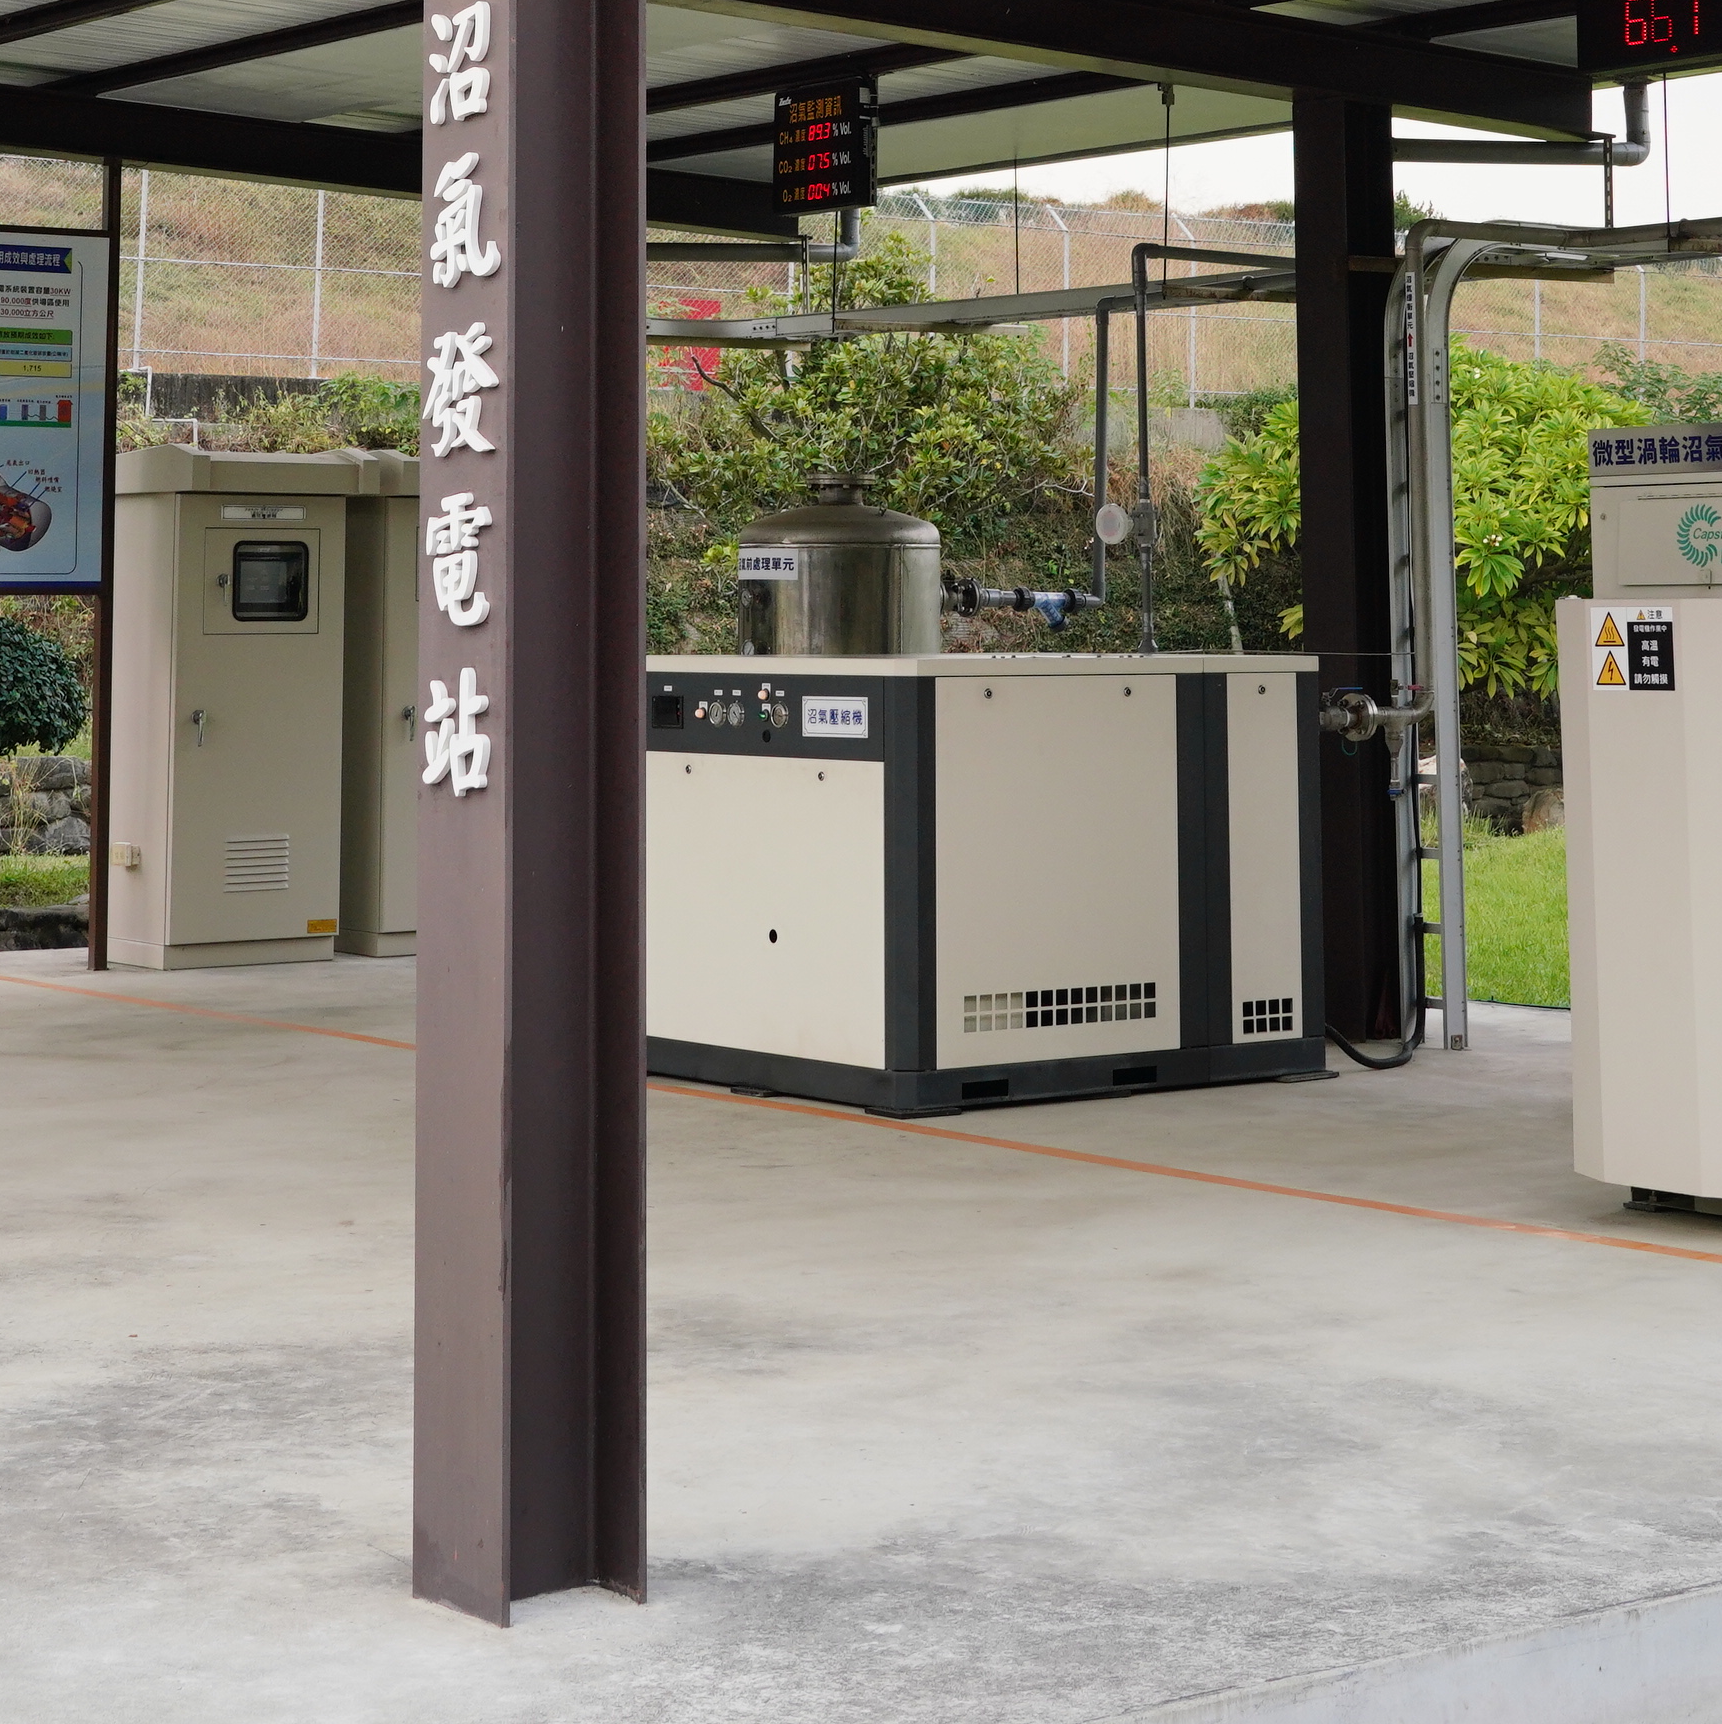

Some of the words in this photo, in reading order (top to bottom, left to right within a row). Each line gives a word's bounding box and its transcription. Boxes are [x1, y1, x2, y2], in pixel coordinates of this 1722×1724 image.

[789, 95, 842, 124] 沼氣監測資訊
[1641, 639, 1659, 652] 高溫
[1641, 655, 1659, 668] 有電
[807, 708, 863, 726] 沼氣壓縮機
